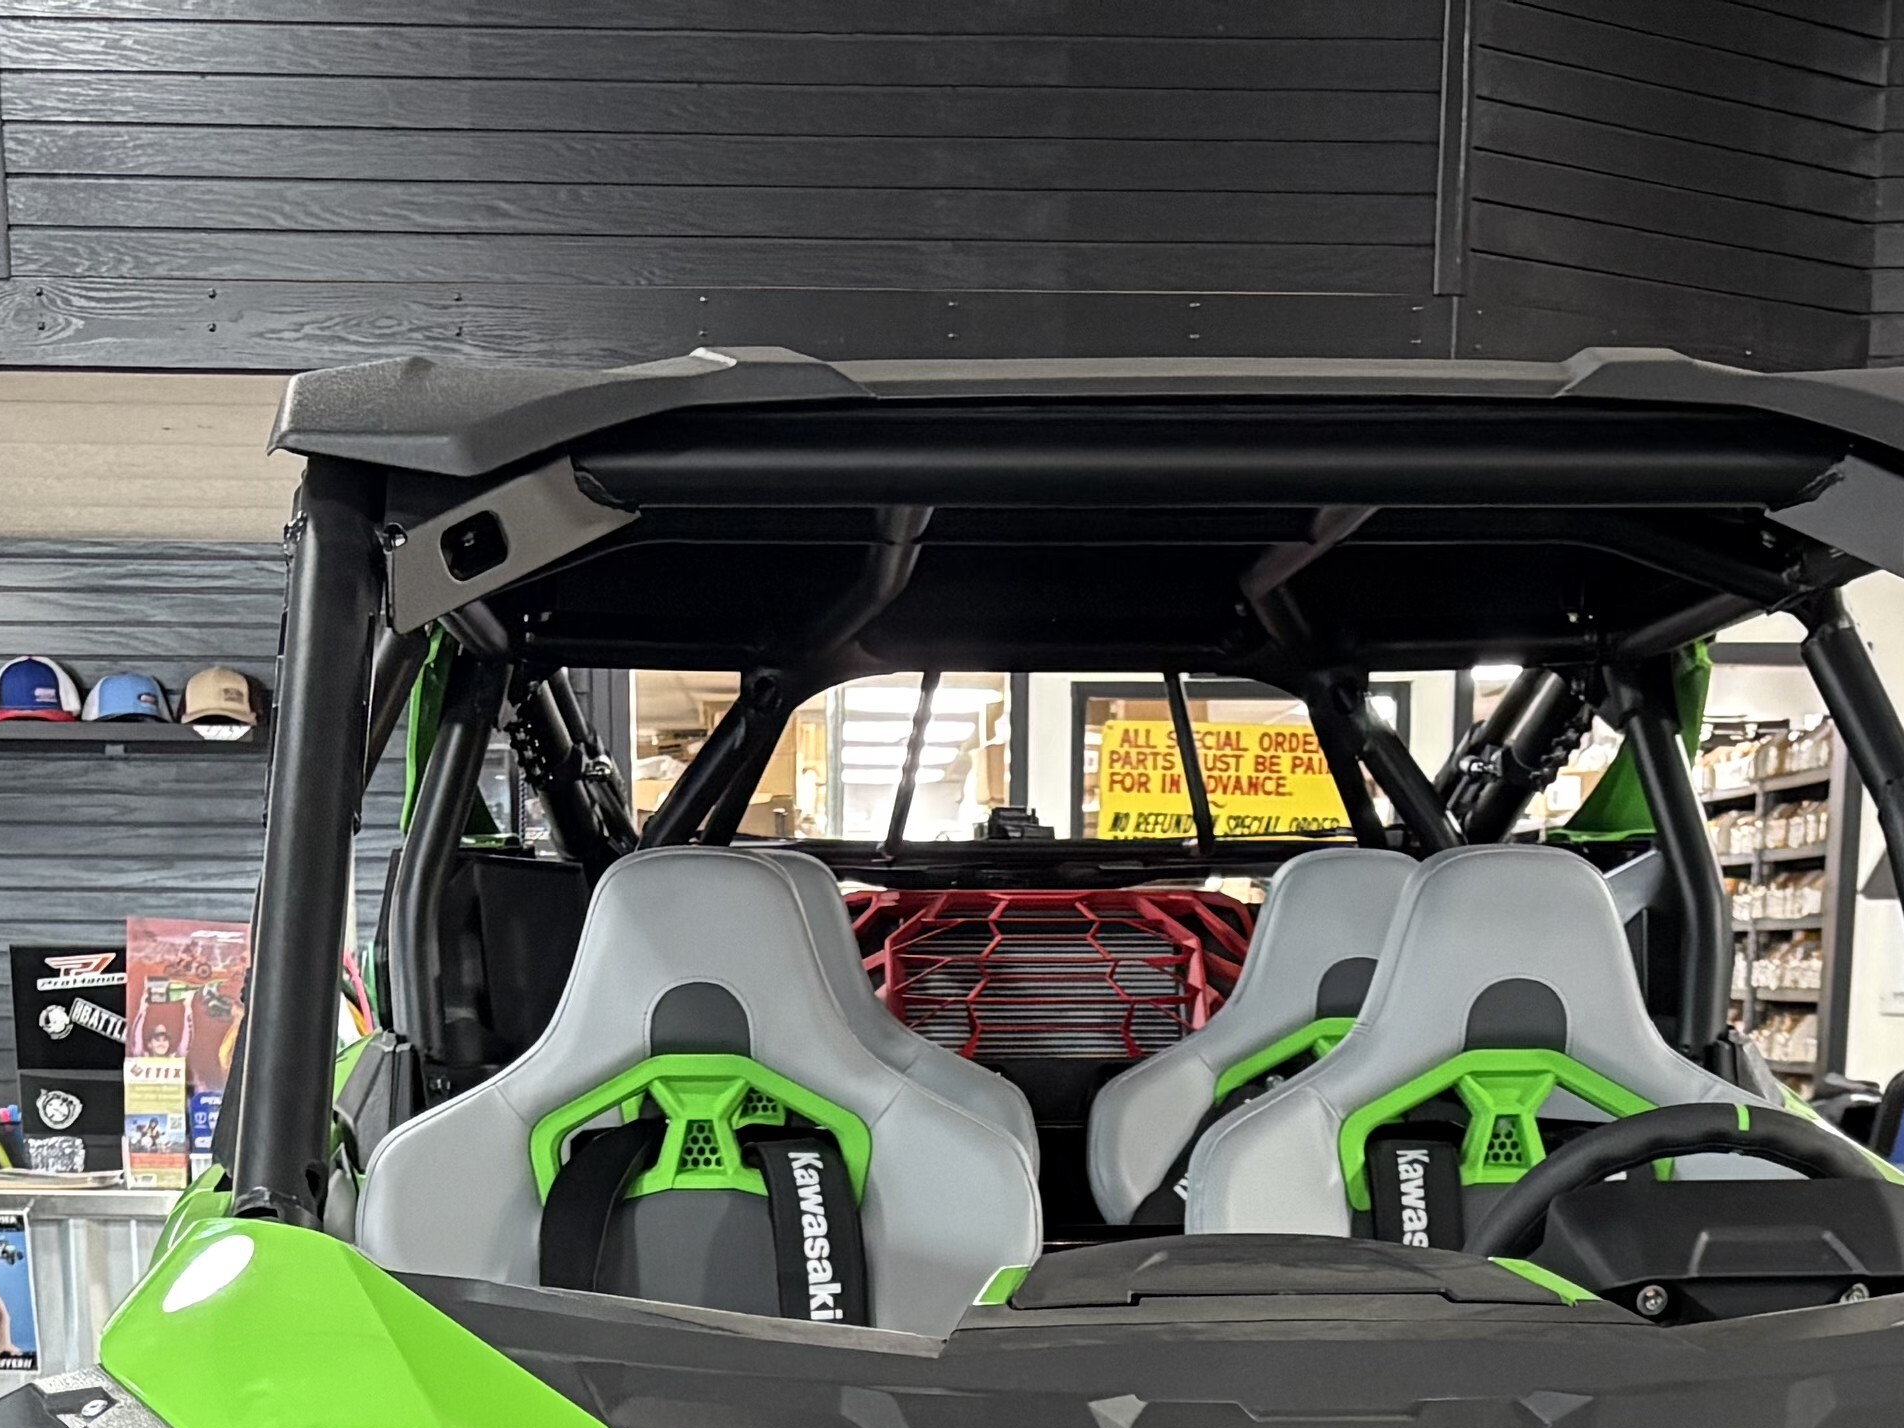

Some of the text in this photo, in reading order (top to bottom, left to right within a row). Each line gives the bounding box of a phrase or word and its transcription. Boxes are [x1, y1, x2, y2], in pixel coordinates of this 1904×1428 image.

[1119, 727, 1158, 750] ALL
[1167, 730, 1249, 752] SECIAL
[1108, 750, 1332, 776] PARTS UST BE PAI
[1108, 772, 1294, 797] FOR IN DVANCE.
[1108, 812, 1131, 833] NO
[1223, 814, 1282, 835] SPECIAL
[1395, 1148, 1431, 1248] Kawas
[787, 1150, 844, 1322] Kawasaki
